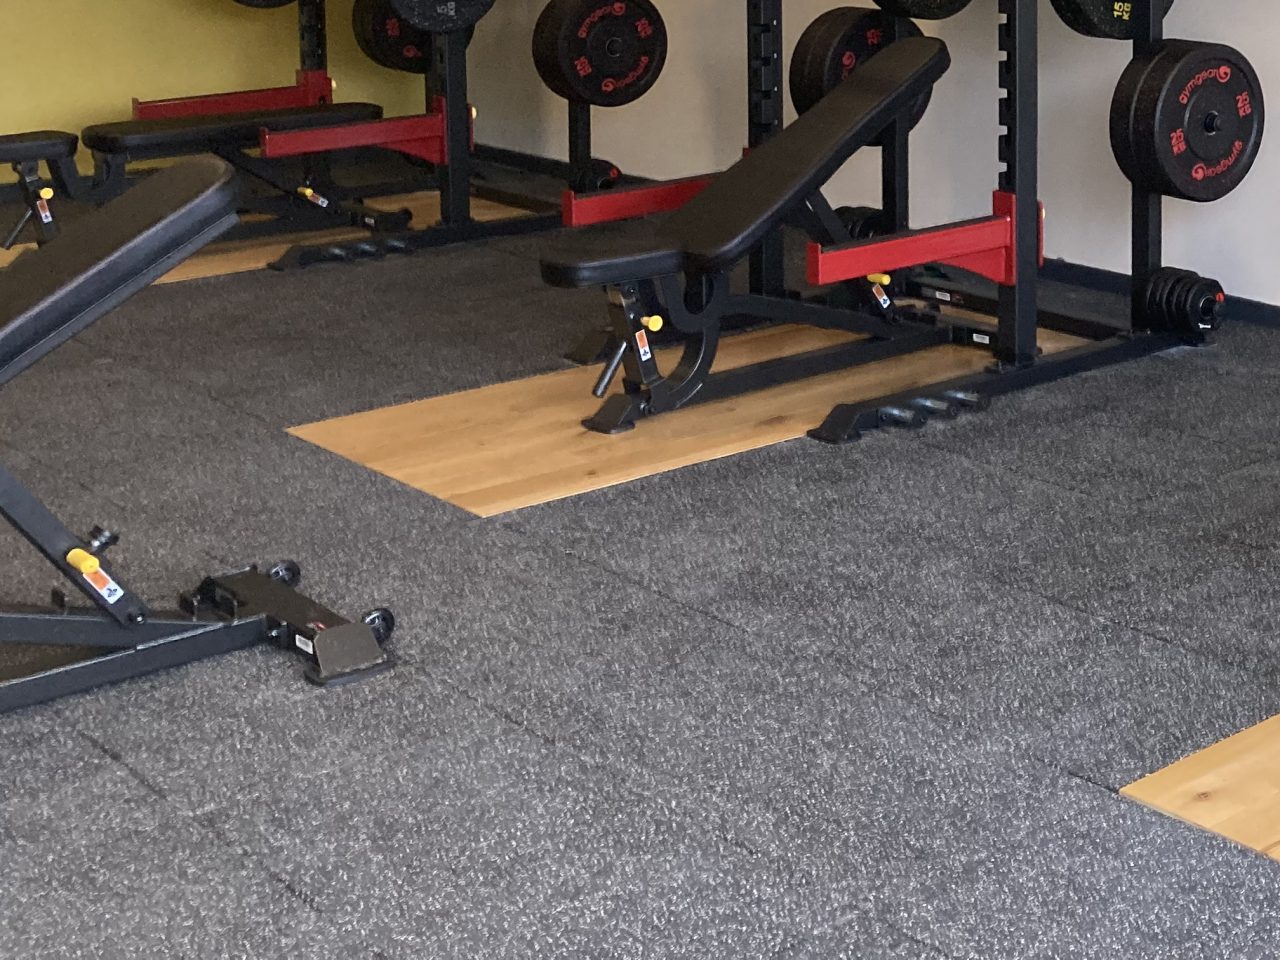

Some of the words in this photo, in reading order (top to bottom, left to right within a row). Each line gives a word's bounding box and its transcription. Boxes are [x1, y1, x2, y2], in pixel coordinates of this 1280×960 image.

[1113, 2, 1124, 18] 15
[1122, 2, 1132, 20] KG
[1179, 68, 1218, 104] gymgear
[1204, 140, 1243, 176] gymgear
